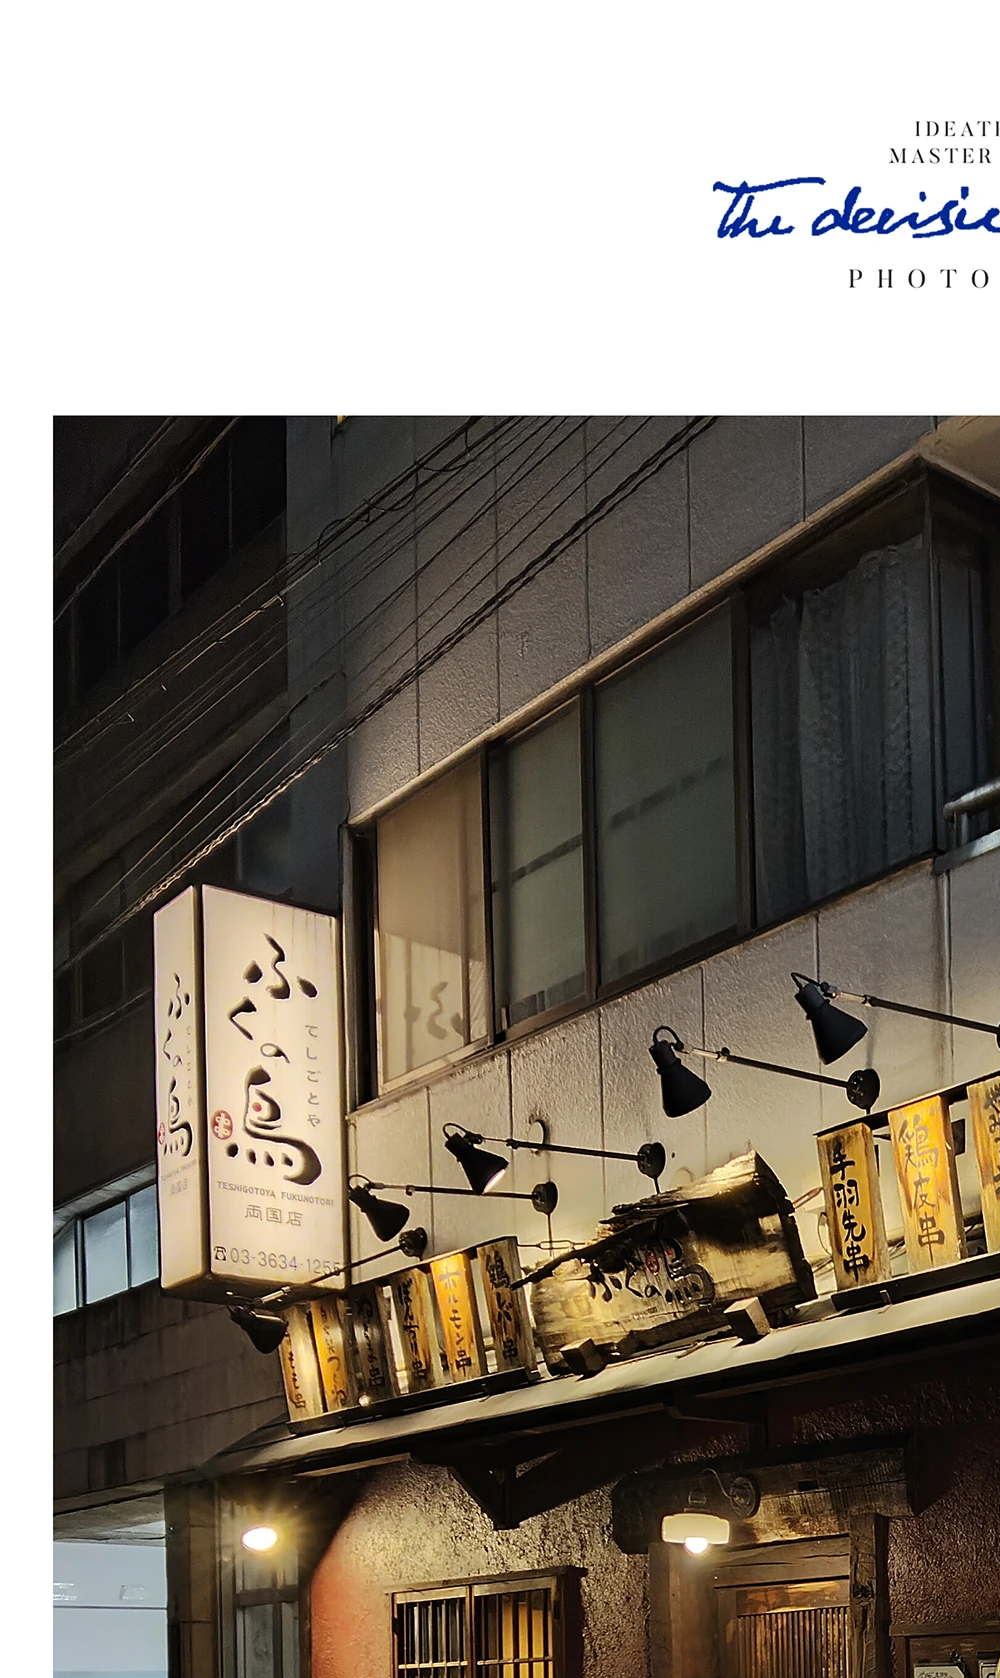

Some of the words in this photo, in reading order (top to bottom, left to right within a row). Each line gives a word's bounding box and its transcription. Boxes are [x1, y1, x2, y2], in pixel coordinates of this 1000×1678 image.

[162, 973, 193, 1157] ふくの鳥
[226, 932, 322, 1186] ふくの鳥
[305, 1024, 321, 1128] てしごとや
[217, 1181, 276, 1198] TESHIGOTOYA
[281, 1192, 335, 1206] FUKUNOTORI
[245, 1204, 303, 1226] 両国店
[830, 1136, 869, 1282] 手羽先串
[438, 1267, 472, 1377] ホルモン串
